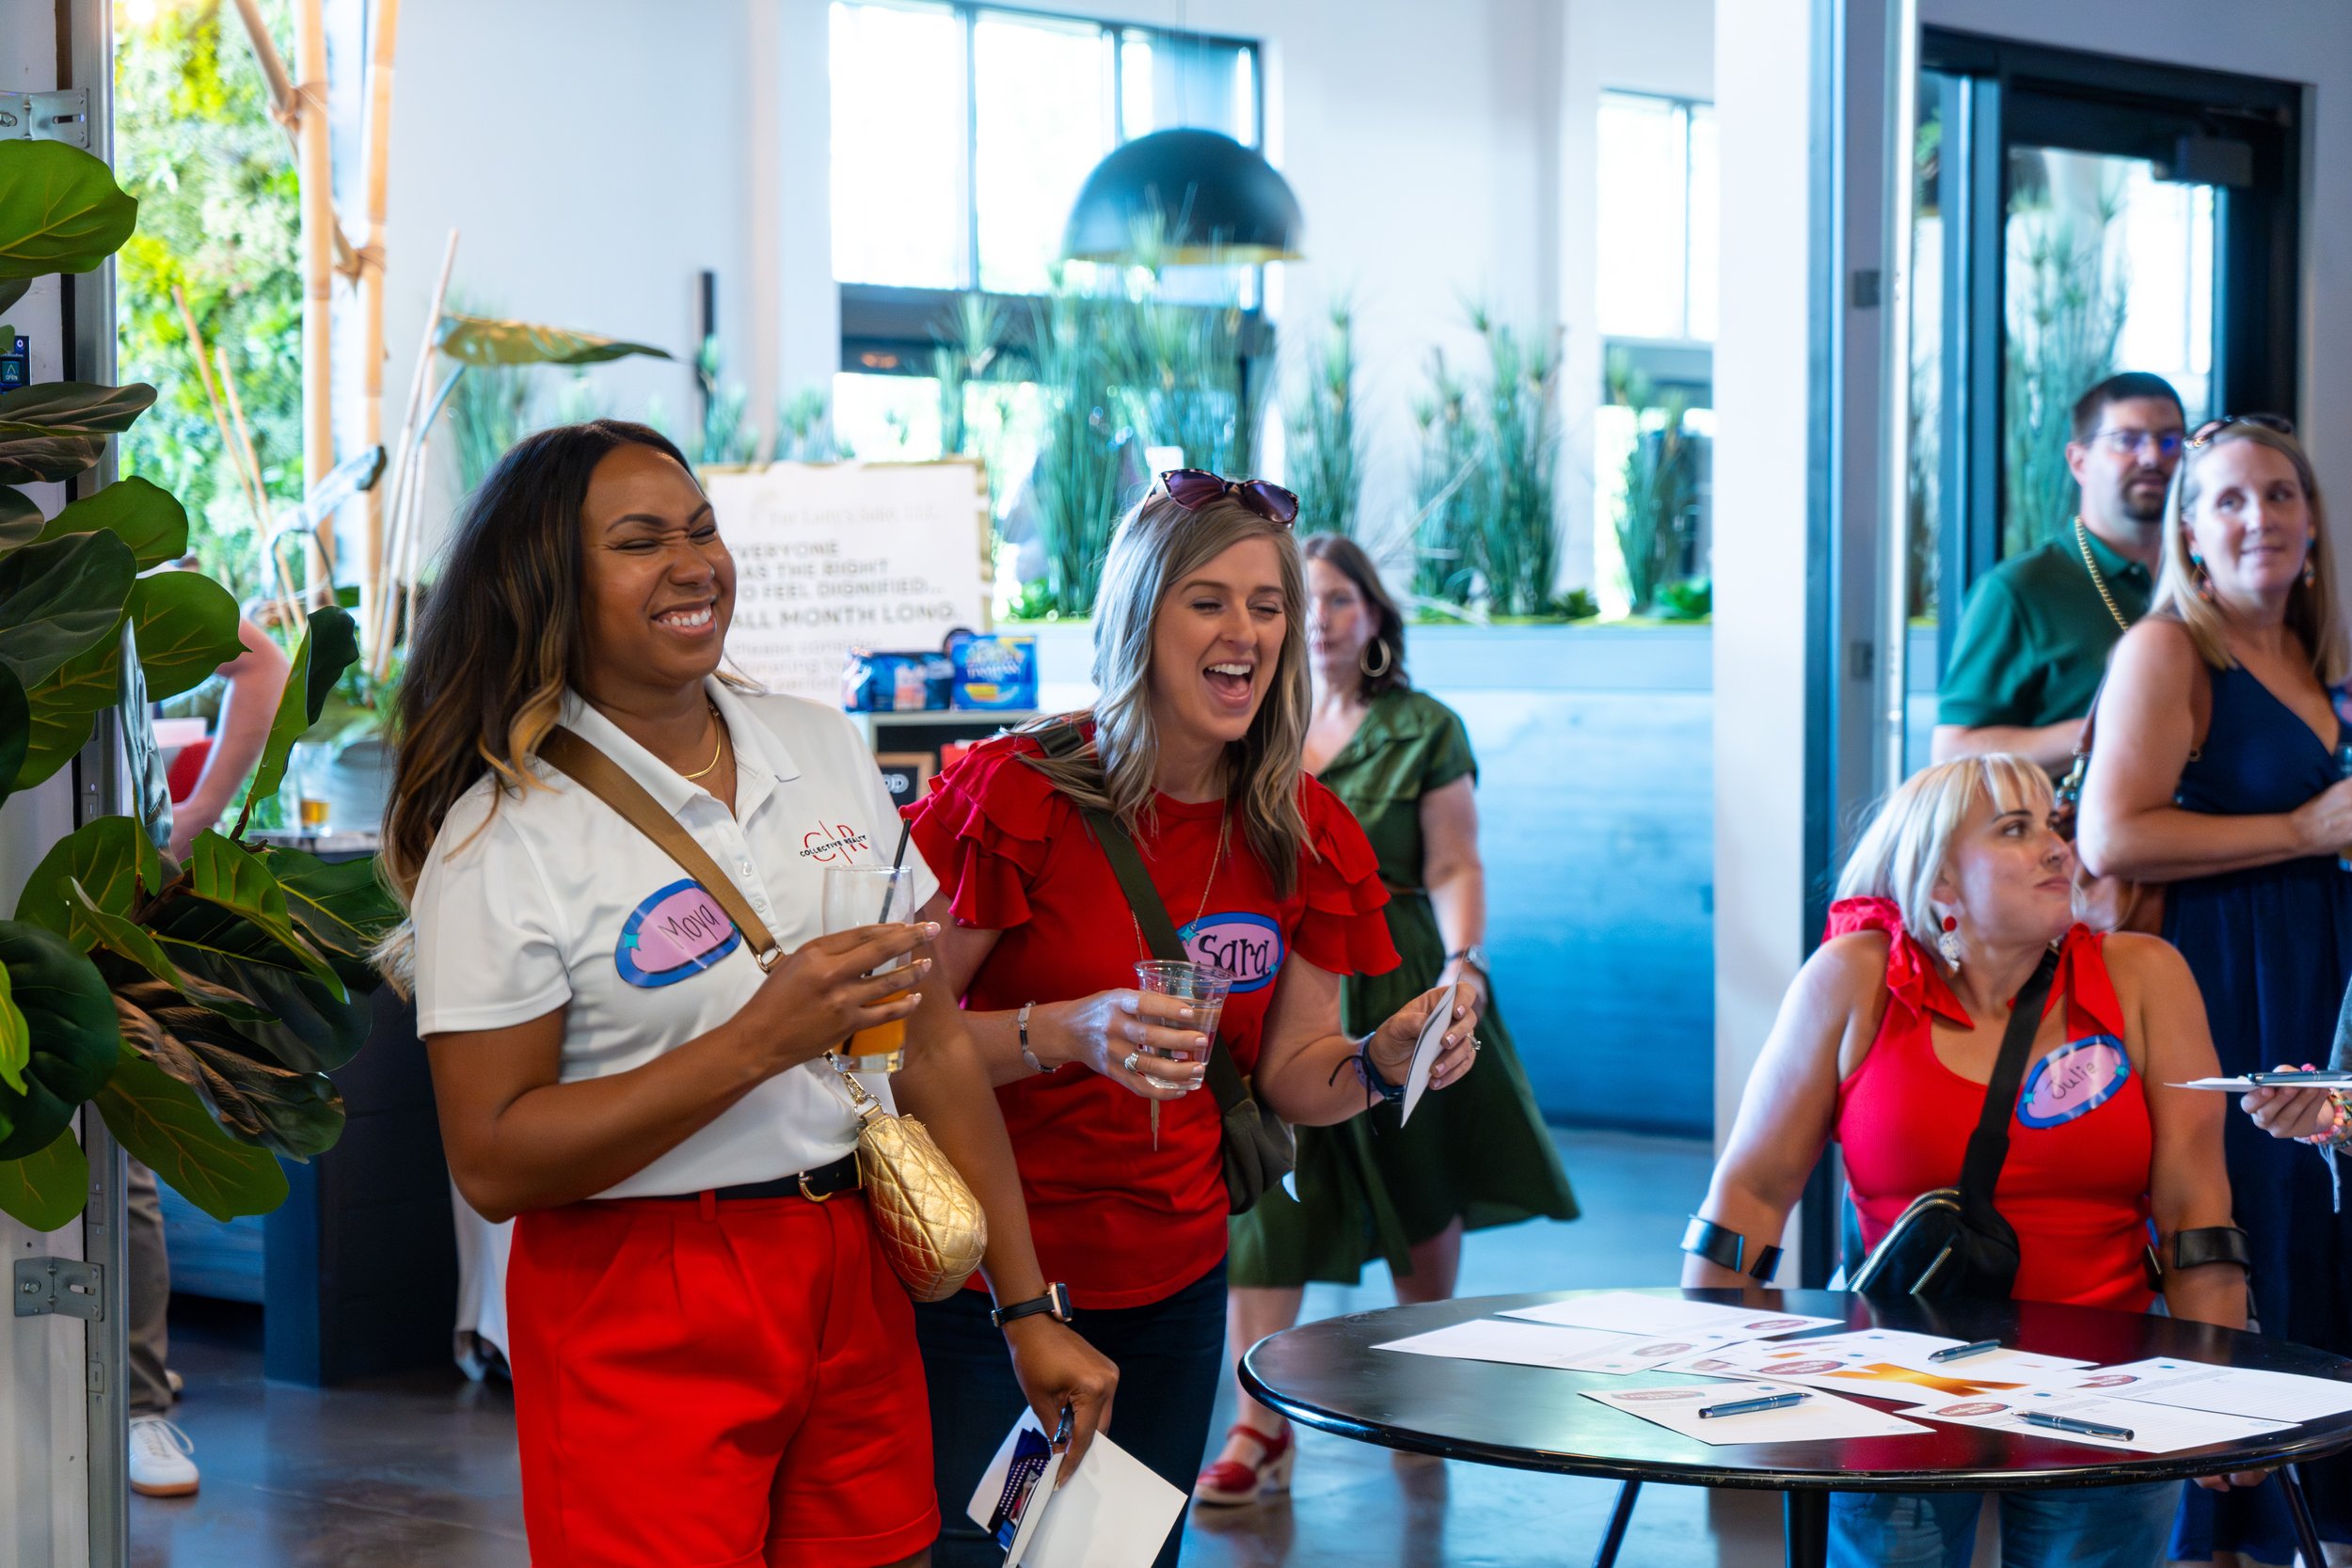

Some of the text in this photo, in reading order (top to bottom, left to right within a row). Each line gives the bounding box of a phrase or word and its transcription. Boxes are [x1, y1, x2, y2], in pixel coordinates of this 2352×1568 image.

[776, 562, 816, 579] THE
[822, 557, 889, 578] RIGHT
[762, 580, 810, 601] FEEL
[780, 607, 877, 628] MONTH
[799, 834, 867, 858] COLLECTIVE REALTY
[1197, 934, 1272, 976] Sara
[2044, 1061, 2098, 1101] Julie
